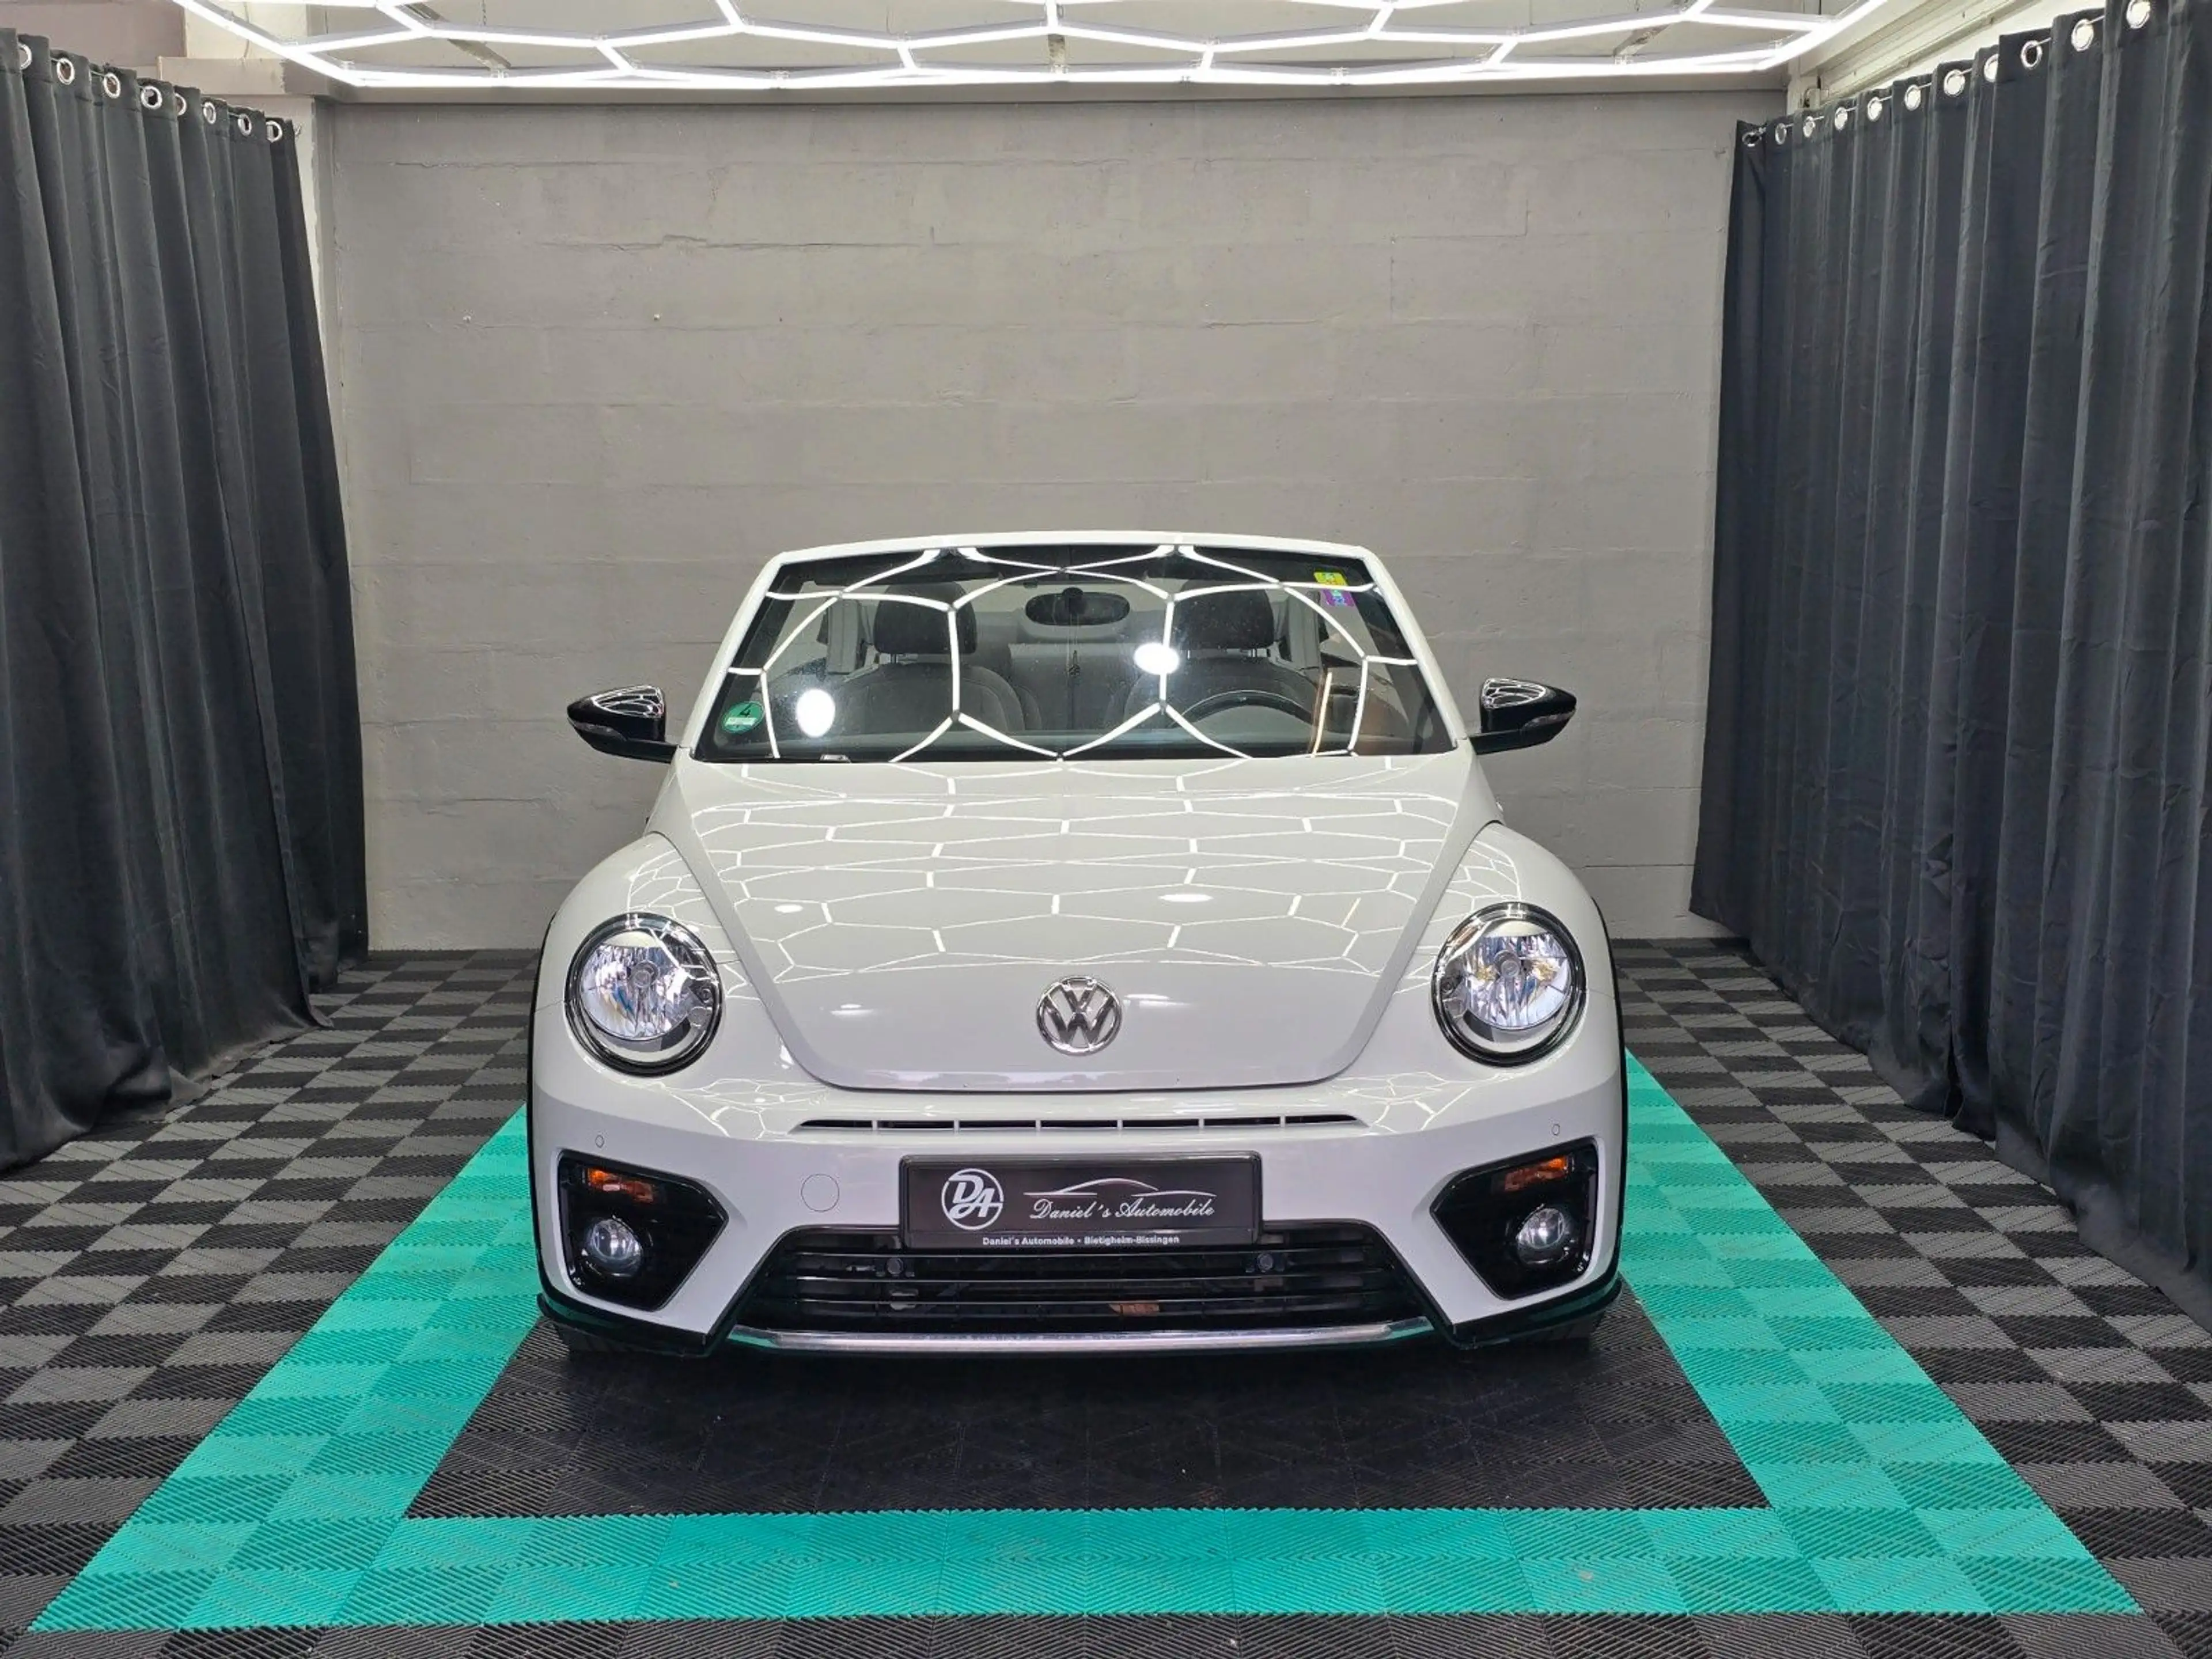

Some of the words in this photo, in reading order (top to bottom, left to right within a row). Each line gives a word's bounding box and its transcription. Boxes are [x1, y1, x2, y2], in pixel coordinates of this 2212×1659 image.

[738, 703, 752, 717] 4
[1114, 1197, 1215, 1218] Automobile
[1021, 1236, 1075, 1245] Automobile
[1084, 1235, 1180, 1246] Bietigheim-Bissingen
